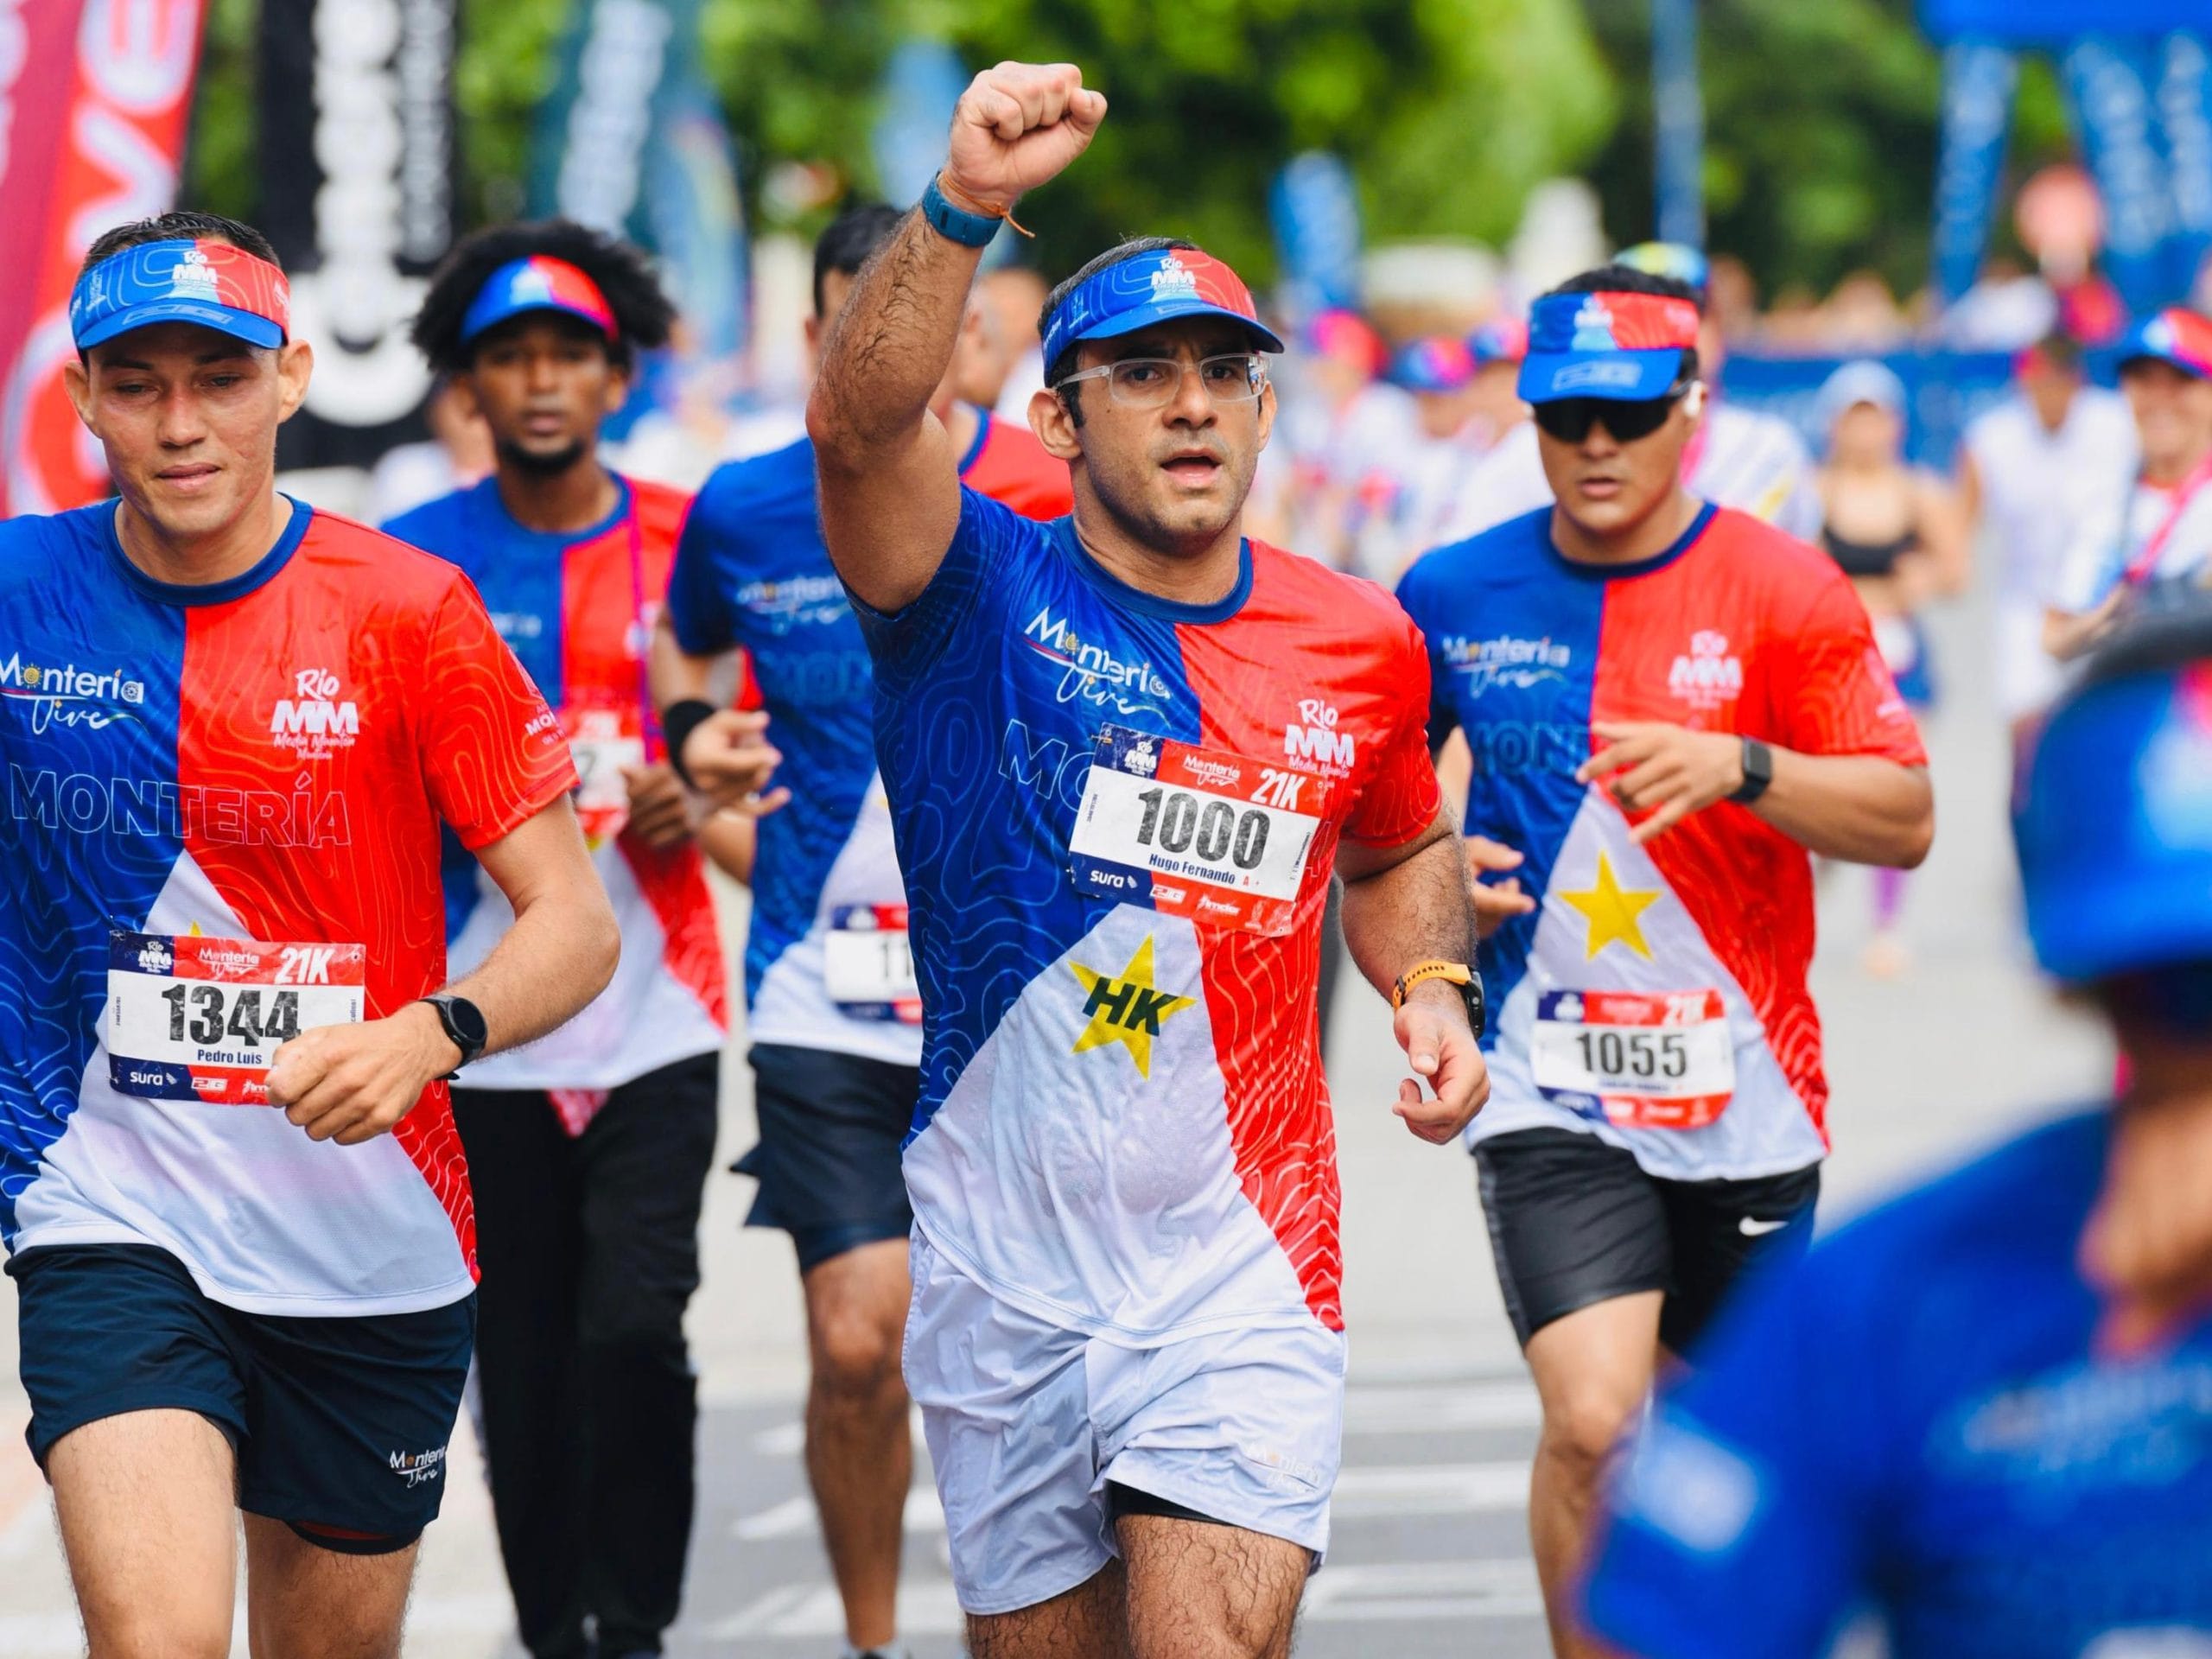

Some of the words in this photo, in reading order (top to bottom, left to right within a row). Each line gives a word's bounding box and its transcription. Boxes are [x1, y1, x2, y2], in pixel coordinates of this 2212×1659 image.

[270, 699, 359, 734] MM
[1284, 723, 1355, 768] MM
[10, 762, 352, 849] MONTERÍA
[1249, 767, 1307, 811] 21K
[1136, 787, 1270, 870] 1000
[1090, 869, 1124, 888] sura
[1149, 854, 1180, 871] Hugo
[1181, 861, 1236, 885] Fernando
[274, 947, 335, 984] 21K
[161, 983, 301, 1047] 1344
[1082, 976, 1179, 1037] HK
[197, 1049, 234, 1064] Pedro
[236, 1051, 263, 1065] Luis
[1576, 1032, 1687, 1078] 1055
[130, 1071, 162, 1086] sura
